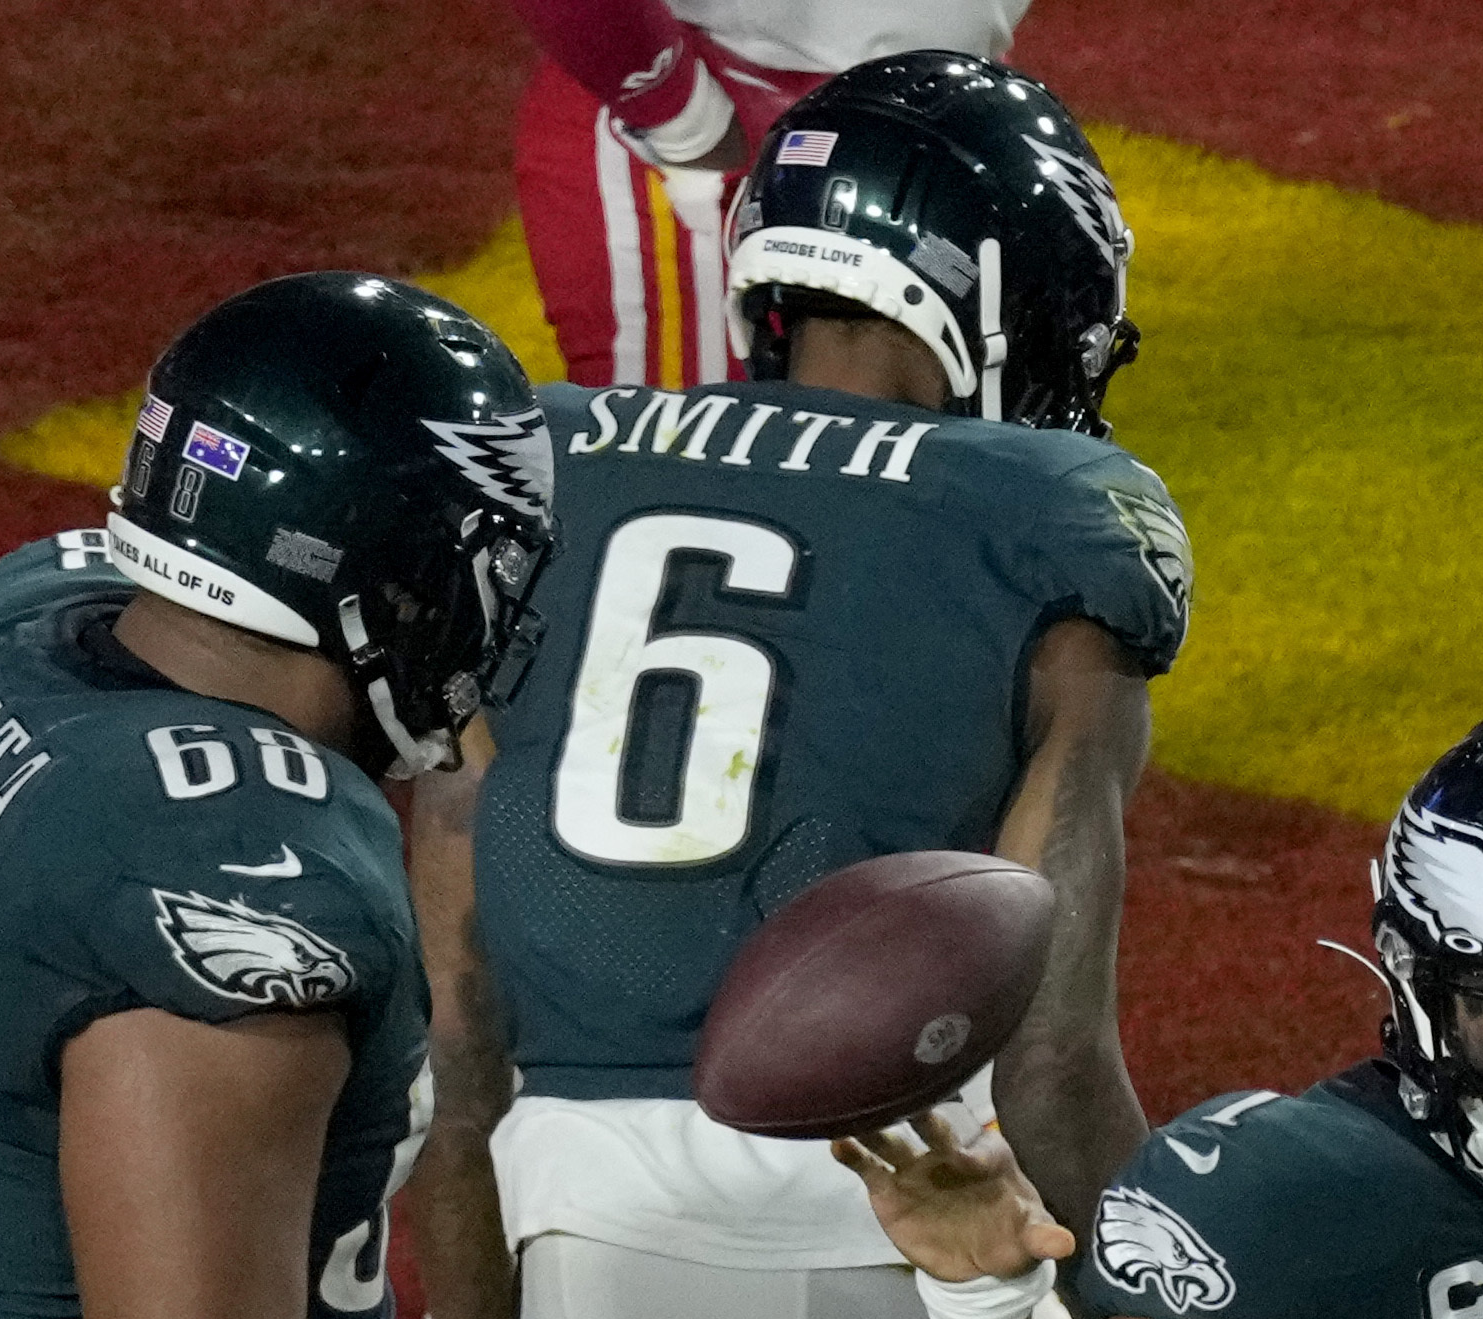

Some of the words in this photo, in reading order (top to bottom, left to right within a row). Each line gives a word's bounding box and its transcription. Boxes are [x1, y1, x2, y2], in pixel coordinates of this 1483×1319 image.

[820, 247, 864, 267] LOVE
[568, 386, 939, 484] SMITH
[142, 552, 173, 580] ALL
[177, 569, 203, 592] OF
[207, 582, 236, 607] US
[552, 512, 798, 866] 6
[144, 722, 330, 800] 68
